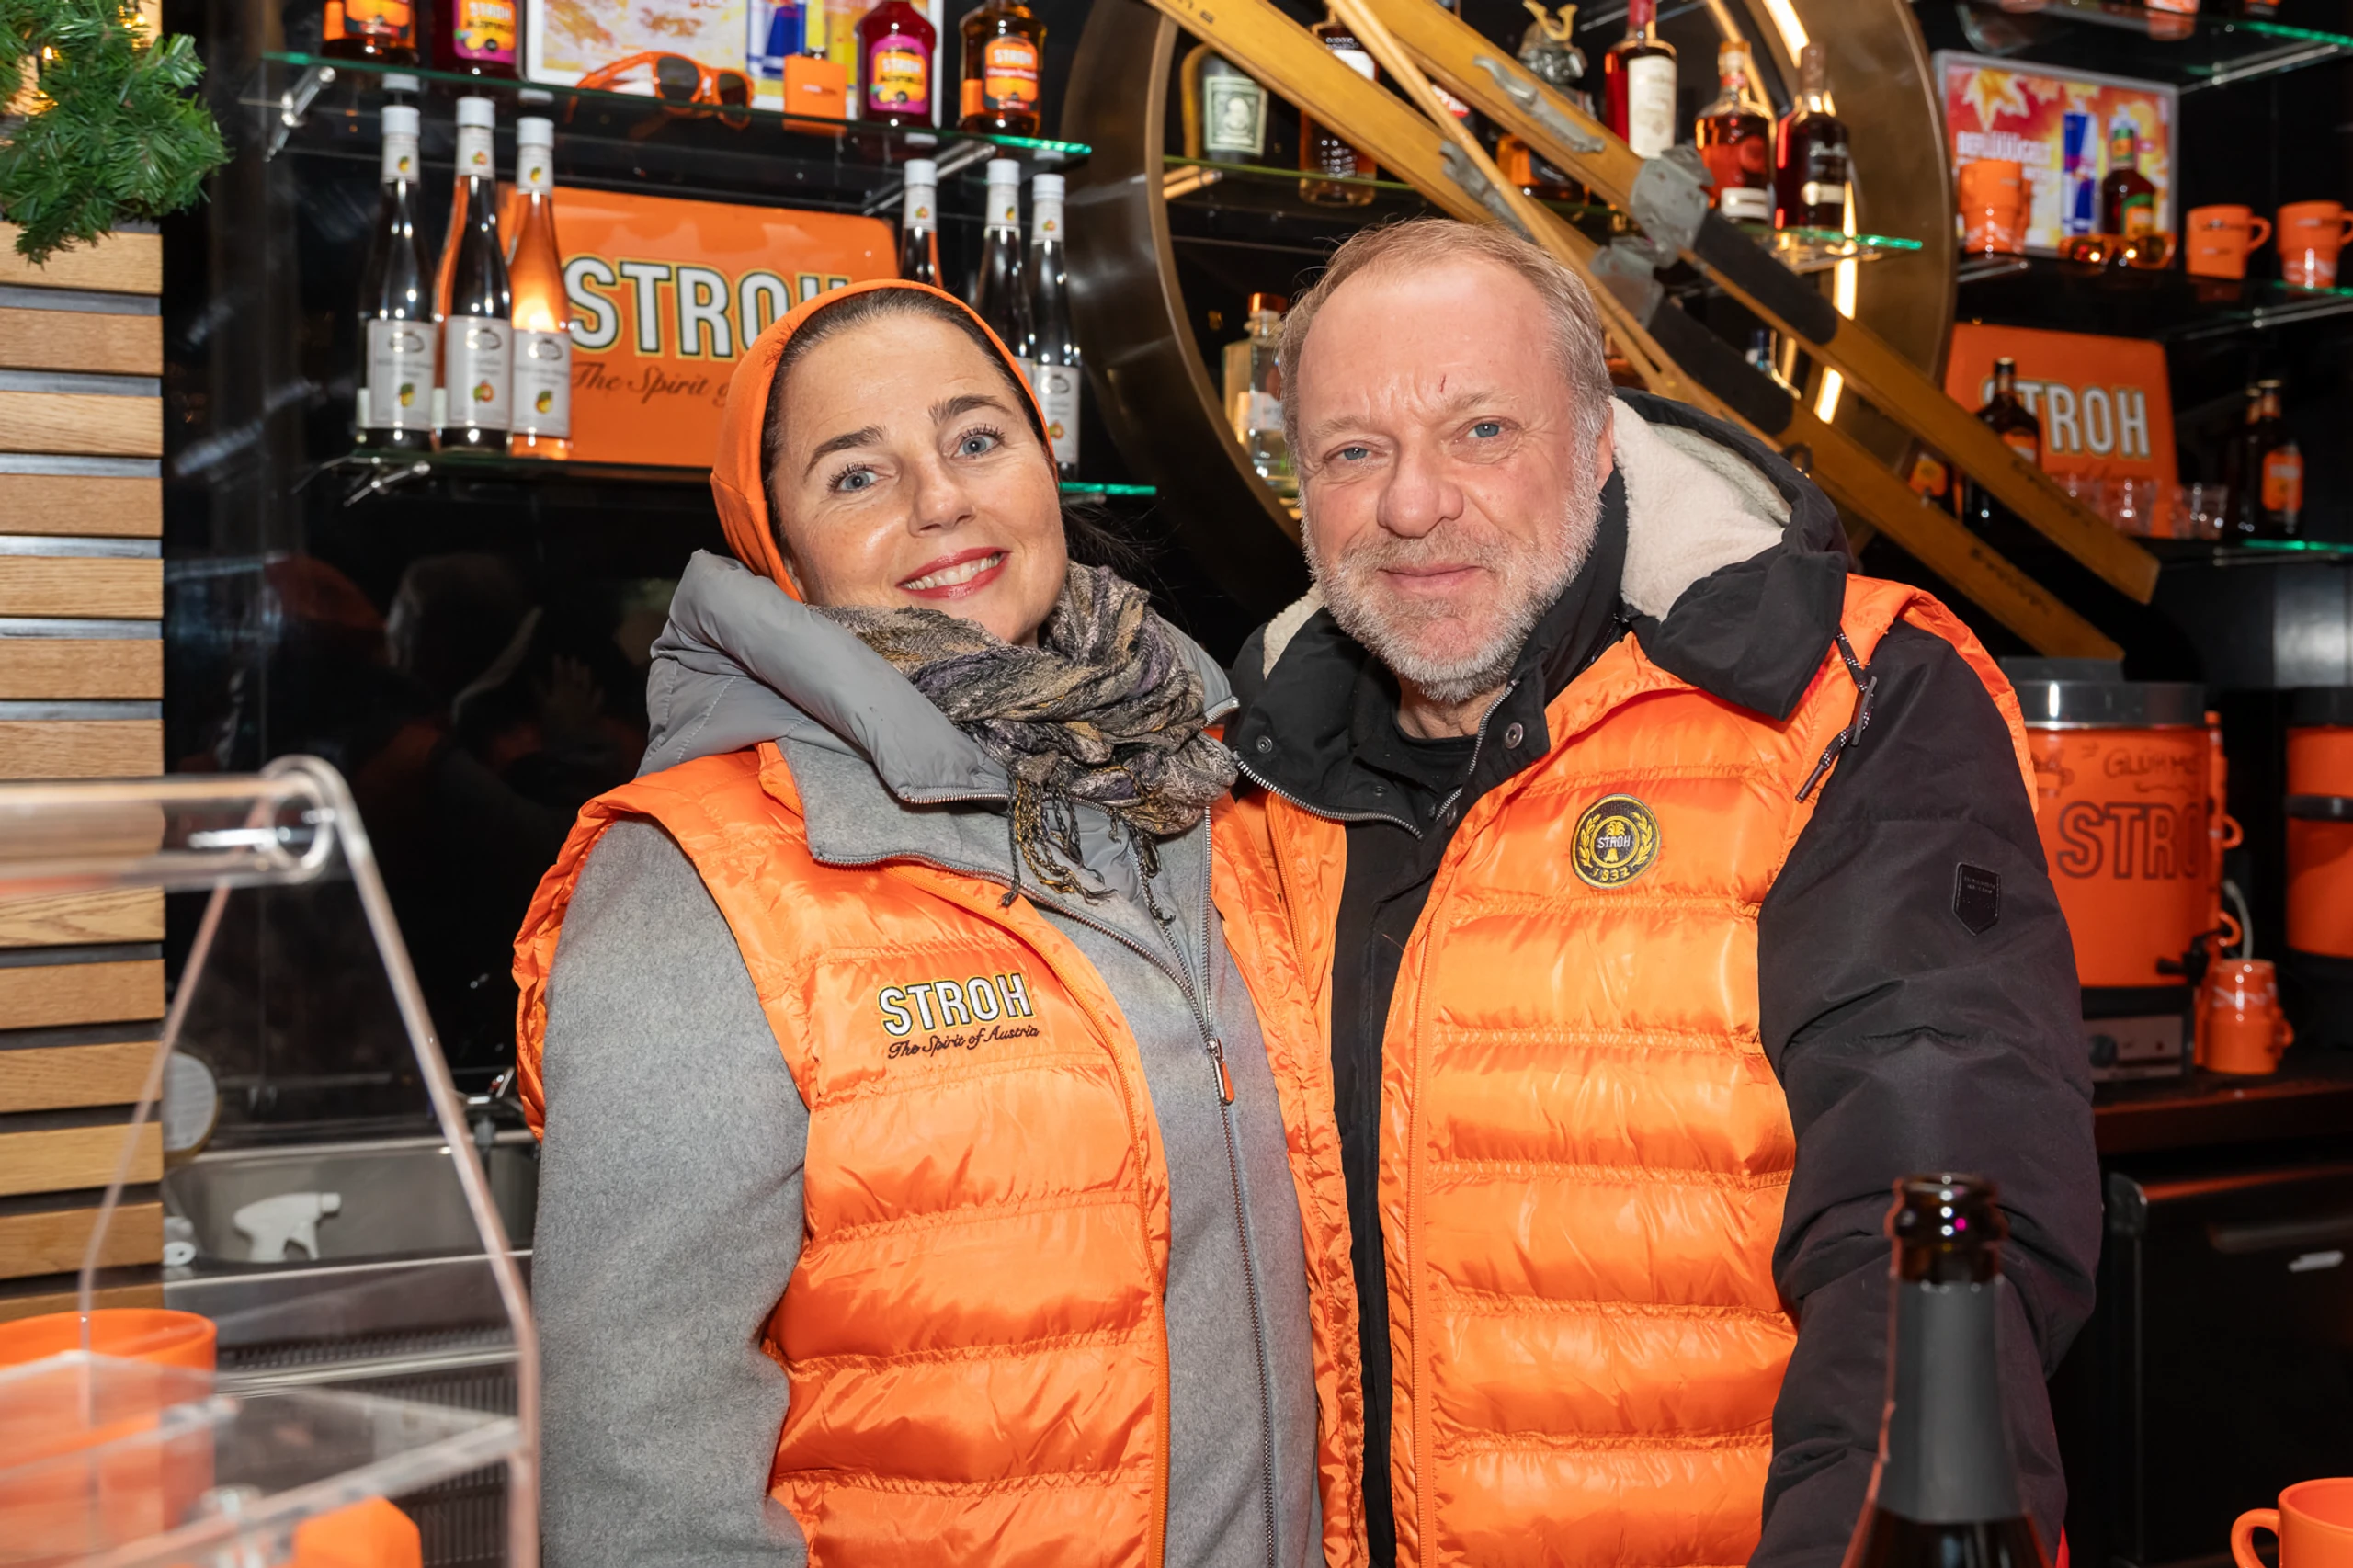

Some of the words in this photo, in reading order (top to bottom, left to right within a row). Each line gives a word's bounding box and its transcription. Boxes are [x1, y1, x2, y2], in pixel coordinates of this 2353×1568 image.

[562, 253, 851, 362] STRO
[572, 361, 622, 392] The
[627, 365, 711, 405] Spirit
[1982, 375, 2153, 461] TROH
[1597, 835, 1631, 849] STROH
[1592, 867, 1631, 881] 1832
[879, 971, 1036, 1037] STROH
[888, 1040, 921, 1059] The
[922, 1035, 966, 1057] Spirit
[967, 1027, 986, 1050] of
[983, 1024, 1040, 1043] Austria
